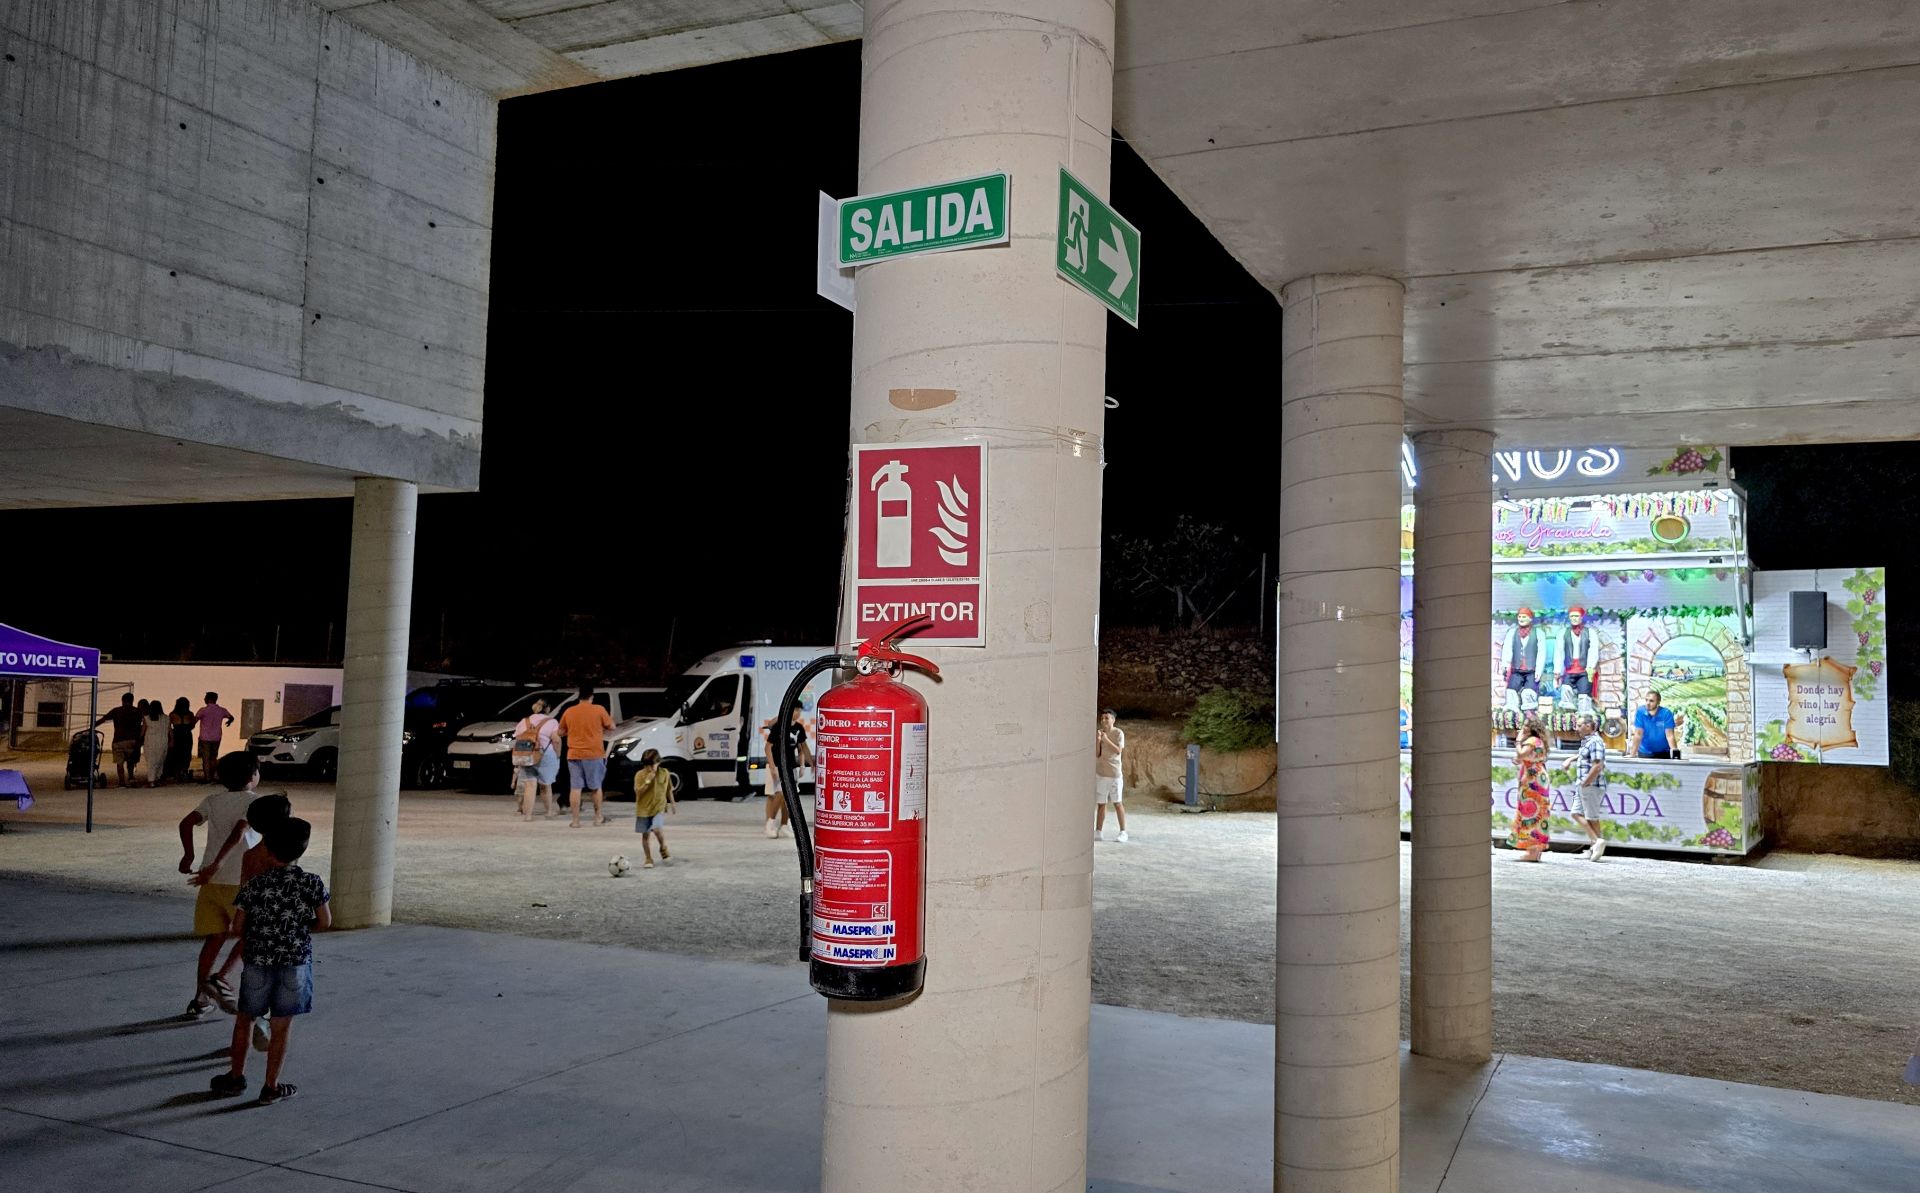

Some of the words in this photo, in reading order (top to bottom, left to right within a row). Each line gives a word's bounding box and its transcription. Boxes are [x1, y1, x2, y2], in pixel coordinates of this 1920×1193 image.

[850, 187, 995, 252] SALIDA
[1520, 516, 1612, 550] Granada
[861, 601, 974, 622] EXTINTOR
[21, 653, 87, 669] VIOLETA
[764, 658, 811, 671] PROTECC
[1797, 685, 1825, 695] Donde
[1828, 685, 1845, 697] hay
[1823, 699, 1841, 711] hay
[825, 719, 851, 728] MICRO
[858, 720, 889, 728] PRESS
[844, 791, 851, 800] B
[876, 791, 885, 801] C
